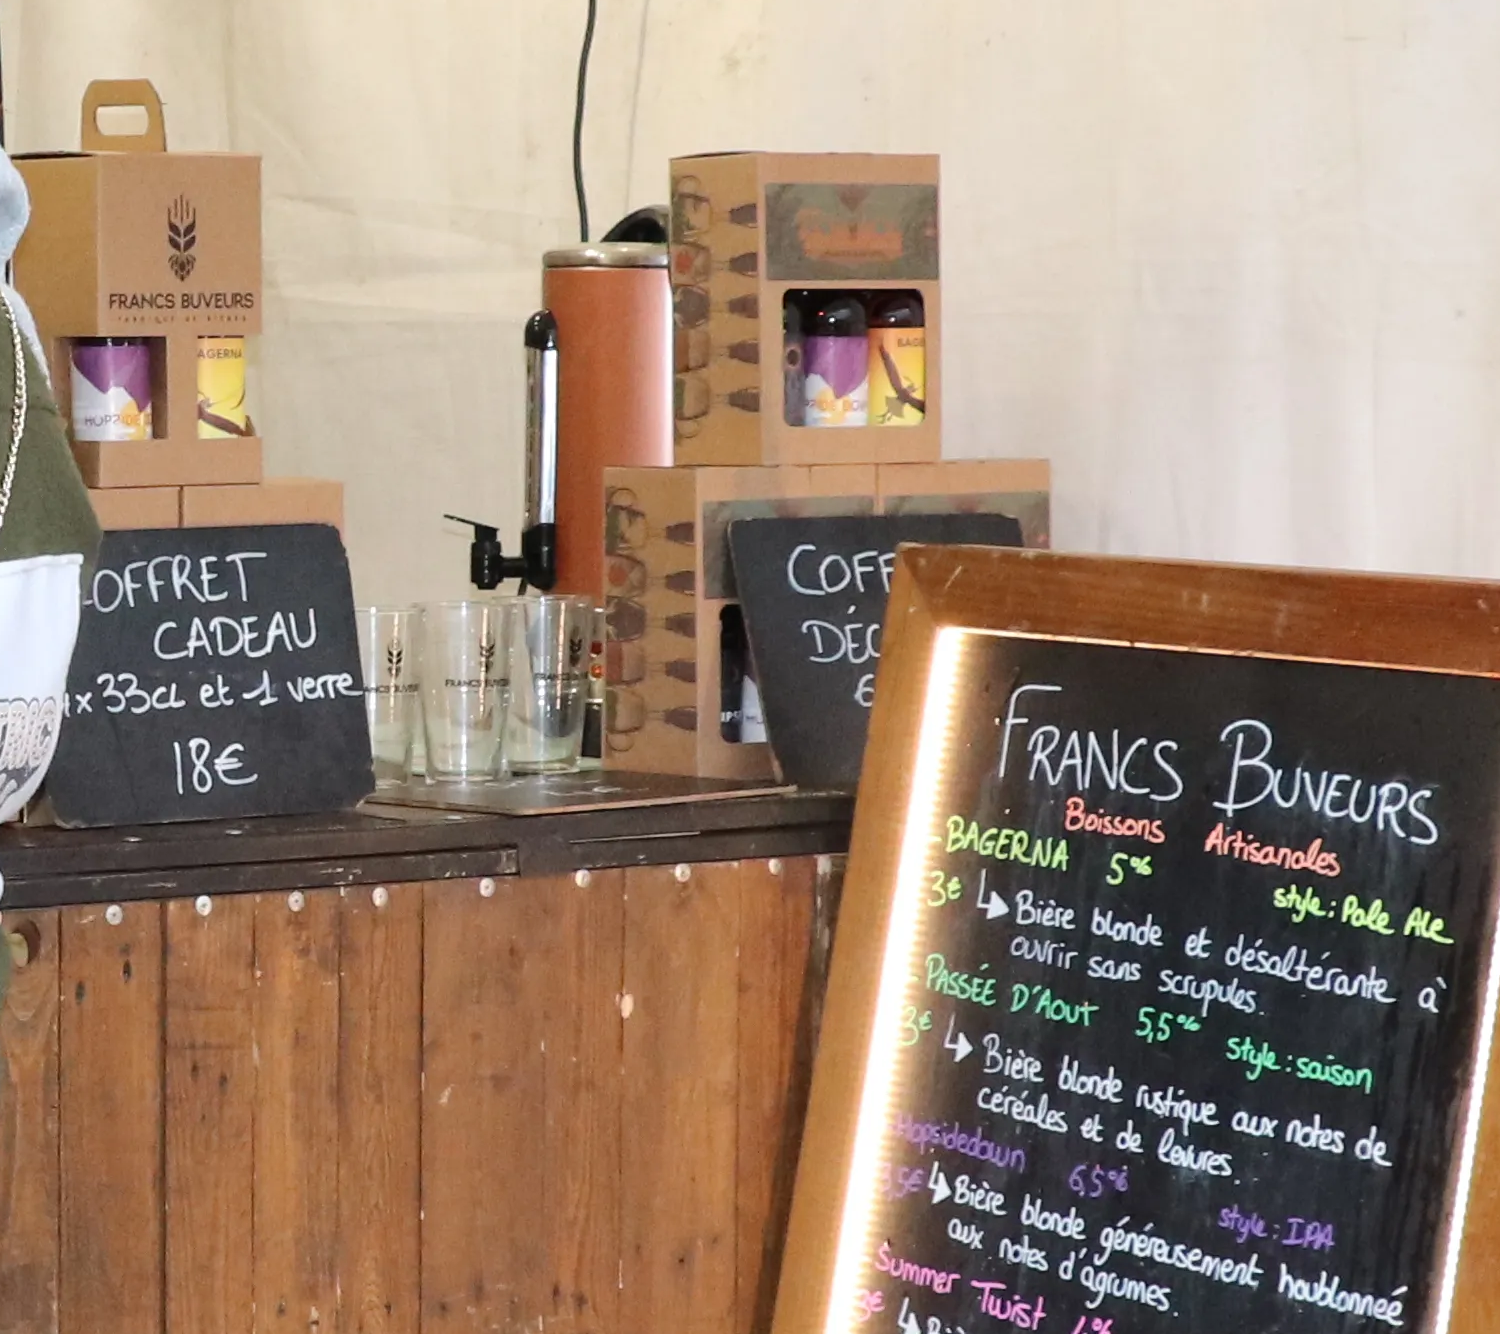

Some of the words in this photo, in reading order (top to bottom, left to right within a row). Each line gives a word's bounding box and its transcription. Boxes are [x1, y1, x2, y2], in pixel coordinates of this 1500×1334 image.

[108, 292, 175, 310] FRANCS
[181, 291, 254, 309] BUVEURS
[196, 348, 243, 359] AGERNA
[84, 552, 267, 613] OFFRET
[153, 607, 317, 660] CADEAU
[199, 674, 235, 709] et
[242, 669, 278, 707] 1
[287, 672, 364, 704] verre
[173, 737, 258, 795] 18€
[1000, 684, 1185, 802] FRANCS
[1212, 719, 1439, 845] BUVEURS
[946, 815, 1070, 872] BAGERNA
[1105, 852, 1153, 886] 5%
[1064, 796, 1167, 844] Boissons
[1204, 822, 1342, 877] Artisanales
[1341, 895, 1395, 935] Pale
[1403, 906, 1455, 944] Ale
[925, 952, 997, 1007] PASSÉE
[1010, 935, 1079, 970] ouvrir
[1087, 955, 1142, 982] sans
[1015, 889, 1077, 930] Bière
[1091, 906, 1165, 948] blonde
[1184, 926, 1212, 959] et
[1225, 933, 1398, 1003] désaltérante
[1418, 976, 1448, 1013] à
[976, 1084, 1069, 1134] céréales
[1080, 1120, 1104, 1144] et
[1116, 1119, 1145, 1154] de
[982, 1032, 1045, 1083] Bière
[1058, 1054, 1124, 1104] blonde
[1135, 1085, 1220, 1136] rustique
[1231, 1110, 1279, 1138] aux
[1285, 1113, 1345, 1154] notes
[1354, 1125, 1393, 1167] de
[953, 1173, 1008, 1216] Bière
[1020, 1194, 1087, 1241] blonde
[1282, 1217, 1336, 1252] IPA
[947, 1217, 985, 1251] aux
[998, 1234, 1050, 1273] notes
[874, 1244, 962, 1294] Summer
[970, 1278, 1048, 1331] Twist
